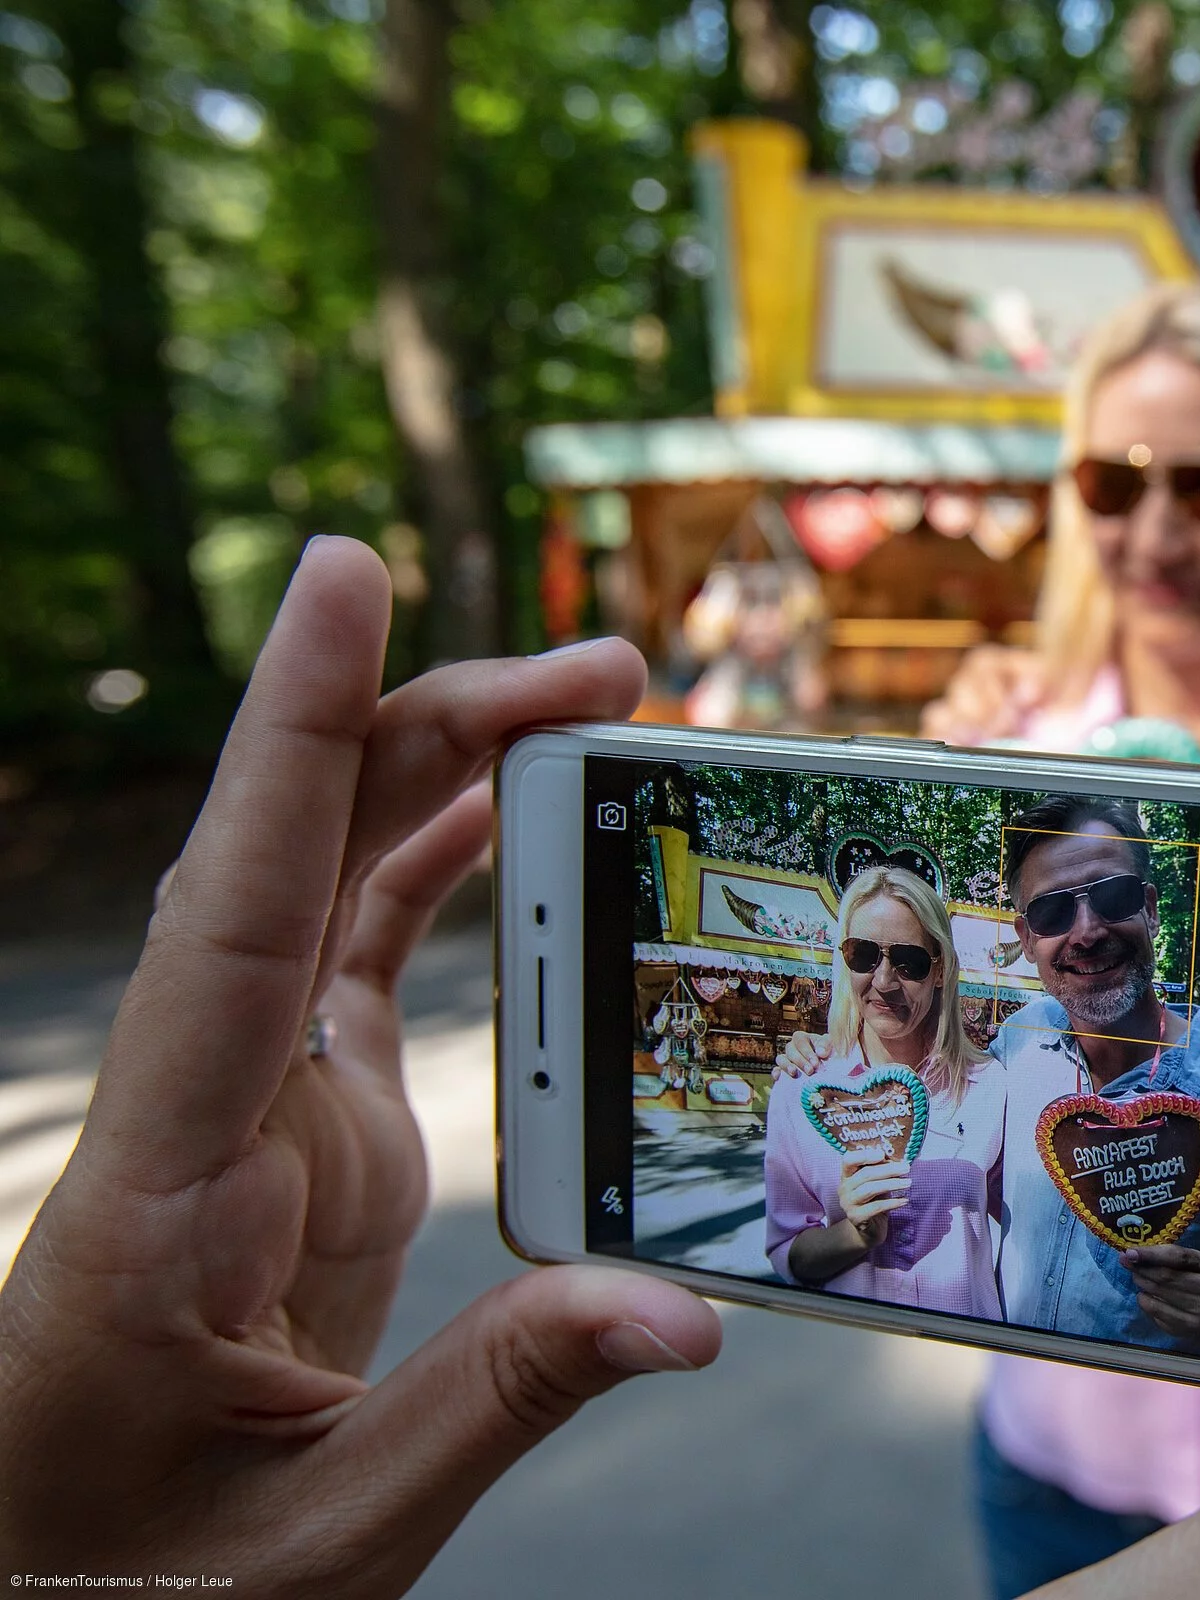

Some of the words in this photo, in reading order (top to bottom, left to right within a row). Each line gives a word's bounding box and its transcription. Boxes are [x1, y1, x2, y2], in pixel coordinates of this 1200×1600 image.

[723, 956, 783, 970] Makronen
[1072, 1133, 1159, 1169] ANNAFEST
[1103, 1166, 1137, 1191] ALLA
[1139, 1156, 1186, 1182] DOOCH
[1099, 1181, 1176, 1214] ANNAFEST
